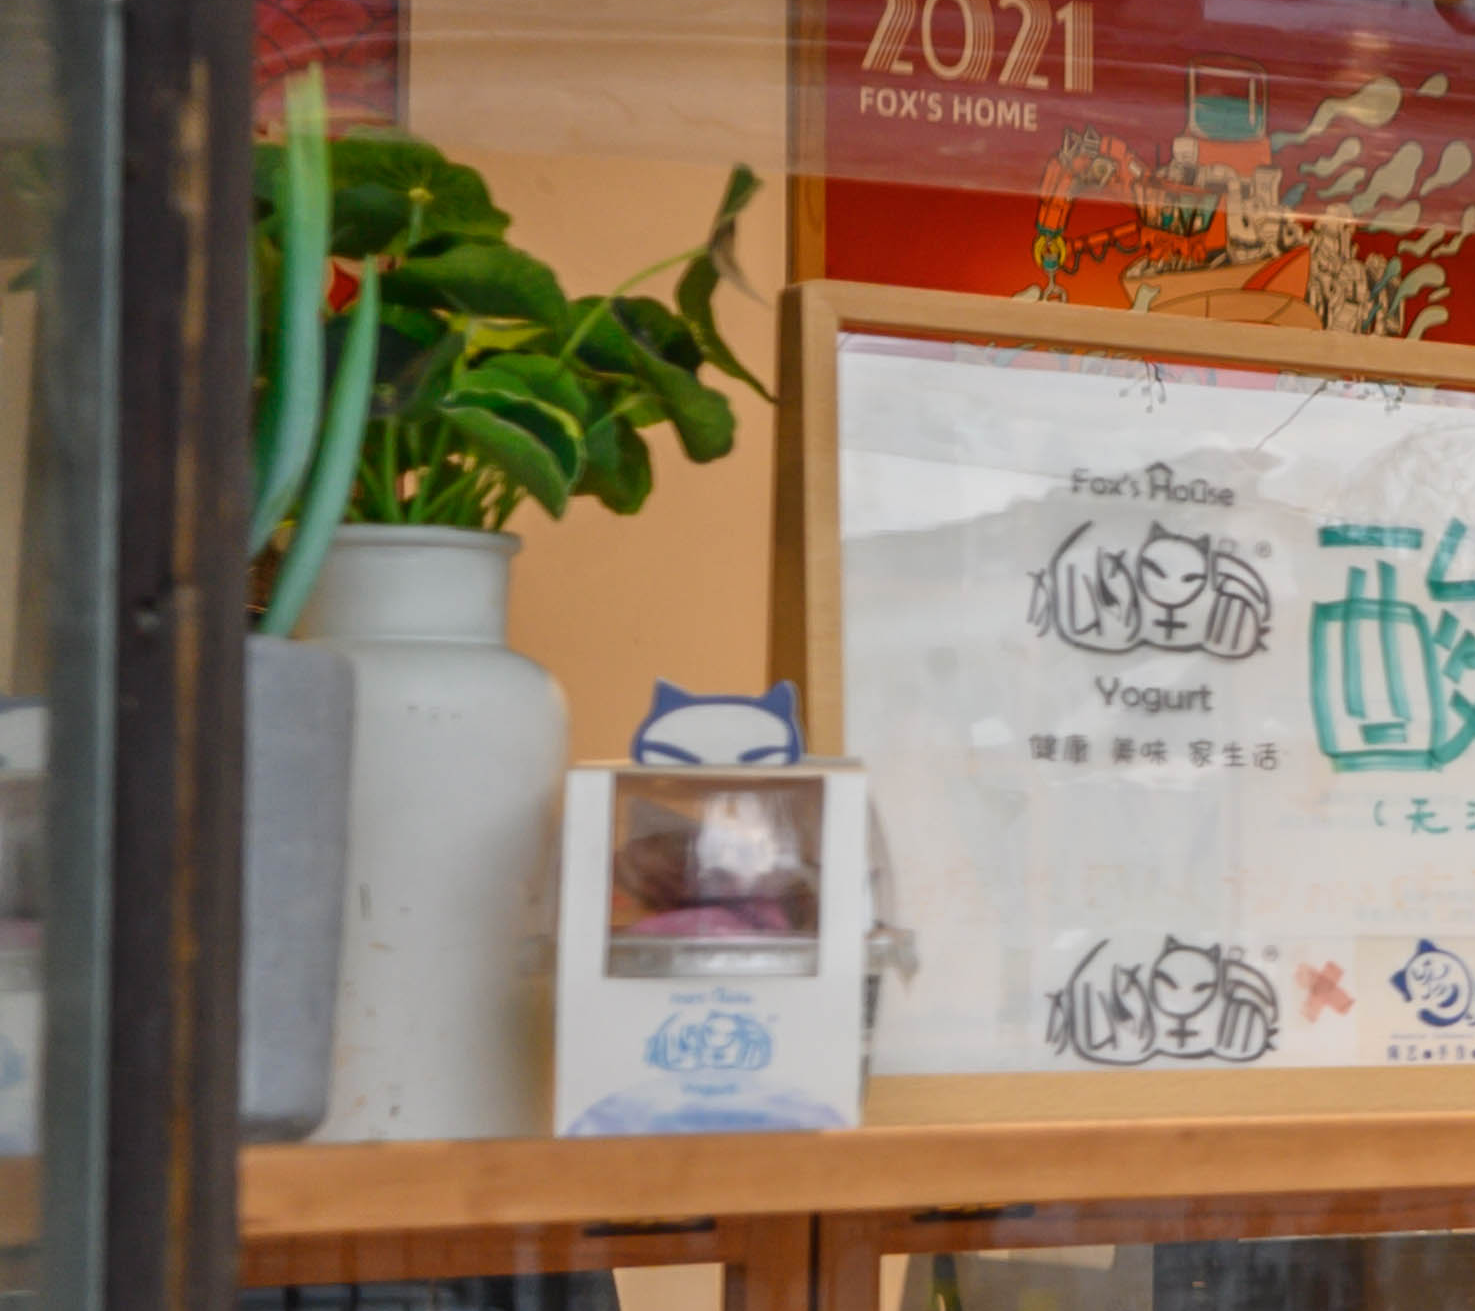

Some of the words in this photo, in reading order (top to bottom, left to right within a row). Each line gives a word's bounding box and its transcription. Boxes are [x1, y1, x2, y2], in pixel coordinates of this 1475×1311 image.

[860, 85, 944, 123] FOX'S
[952, 93, 1039, 133] HOME
[1094, 676, 1215, 714] Yogurt
